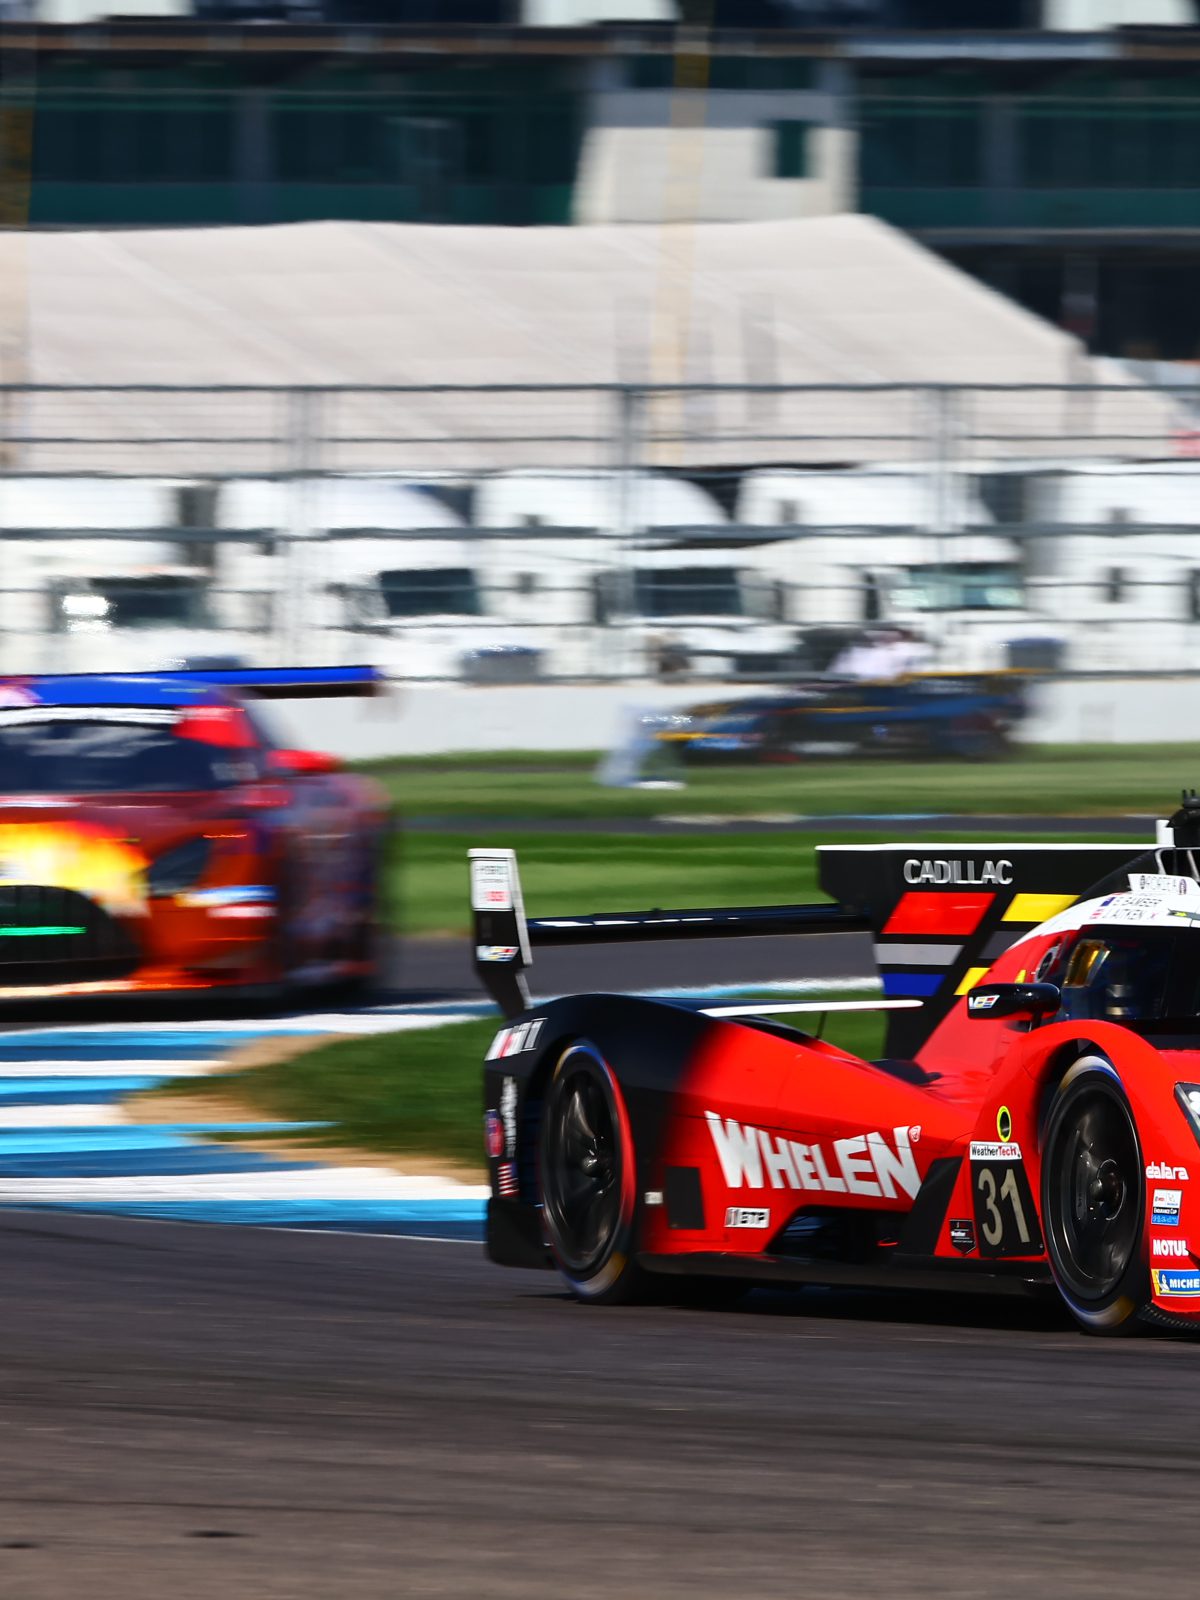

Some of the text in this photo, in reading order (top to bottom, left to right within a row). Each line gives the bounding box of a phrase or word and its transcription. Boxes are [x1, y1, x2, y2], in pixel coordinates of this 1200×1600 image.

[903, 859, 1013, 885] CADILLAC
[704, 1110, 923, 1200] WHELEN
[971, 1145, 1017, 1156] WeatherTech
[1145, 1161, 1189, 1180] dallara
[978, 1168, 1031, 1246] 31
[1152, 1239, 1189, 1257] MOTUL
